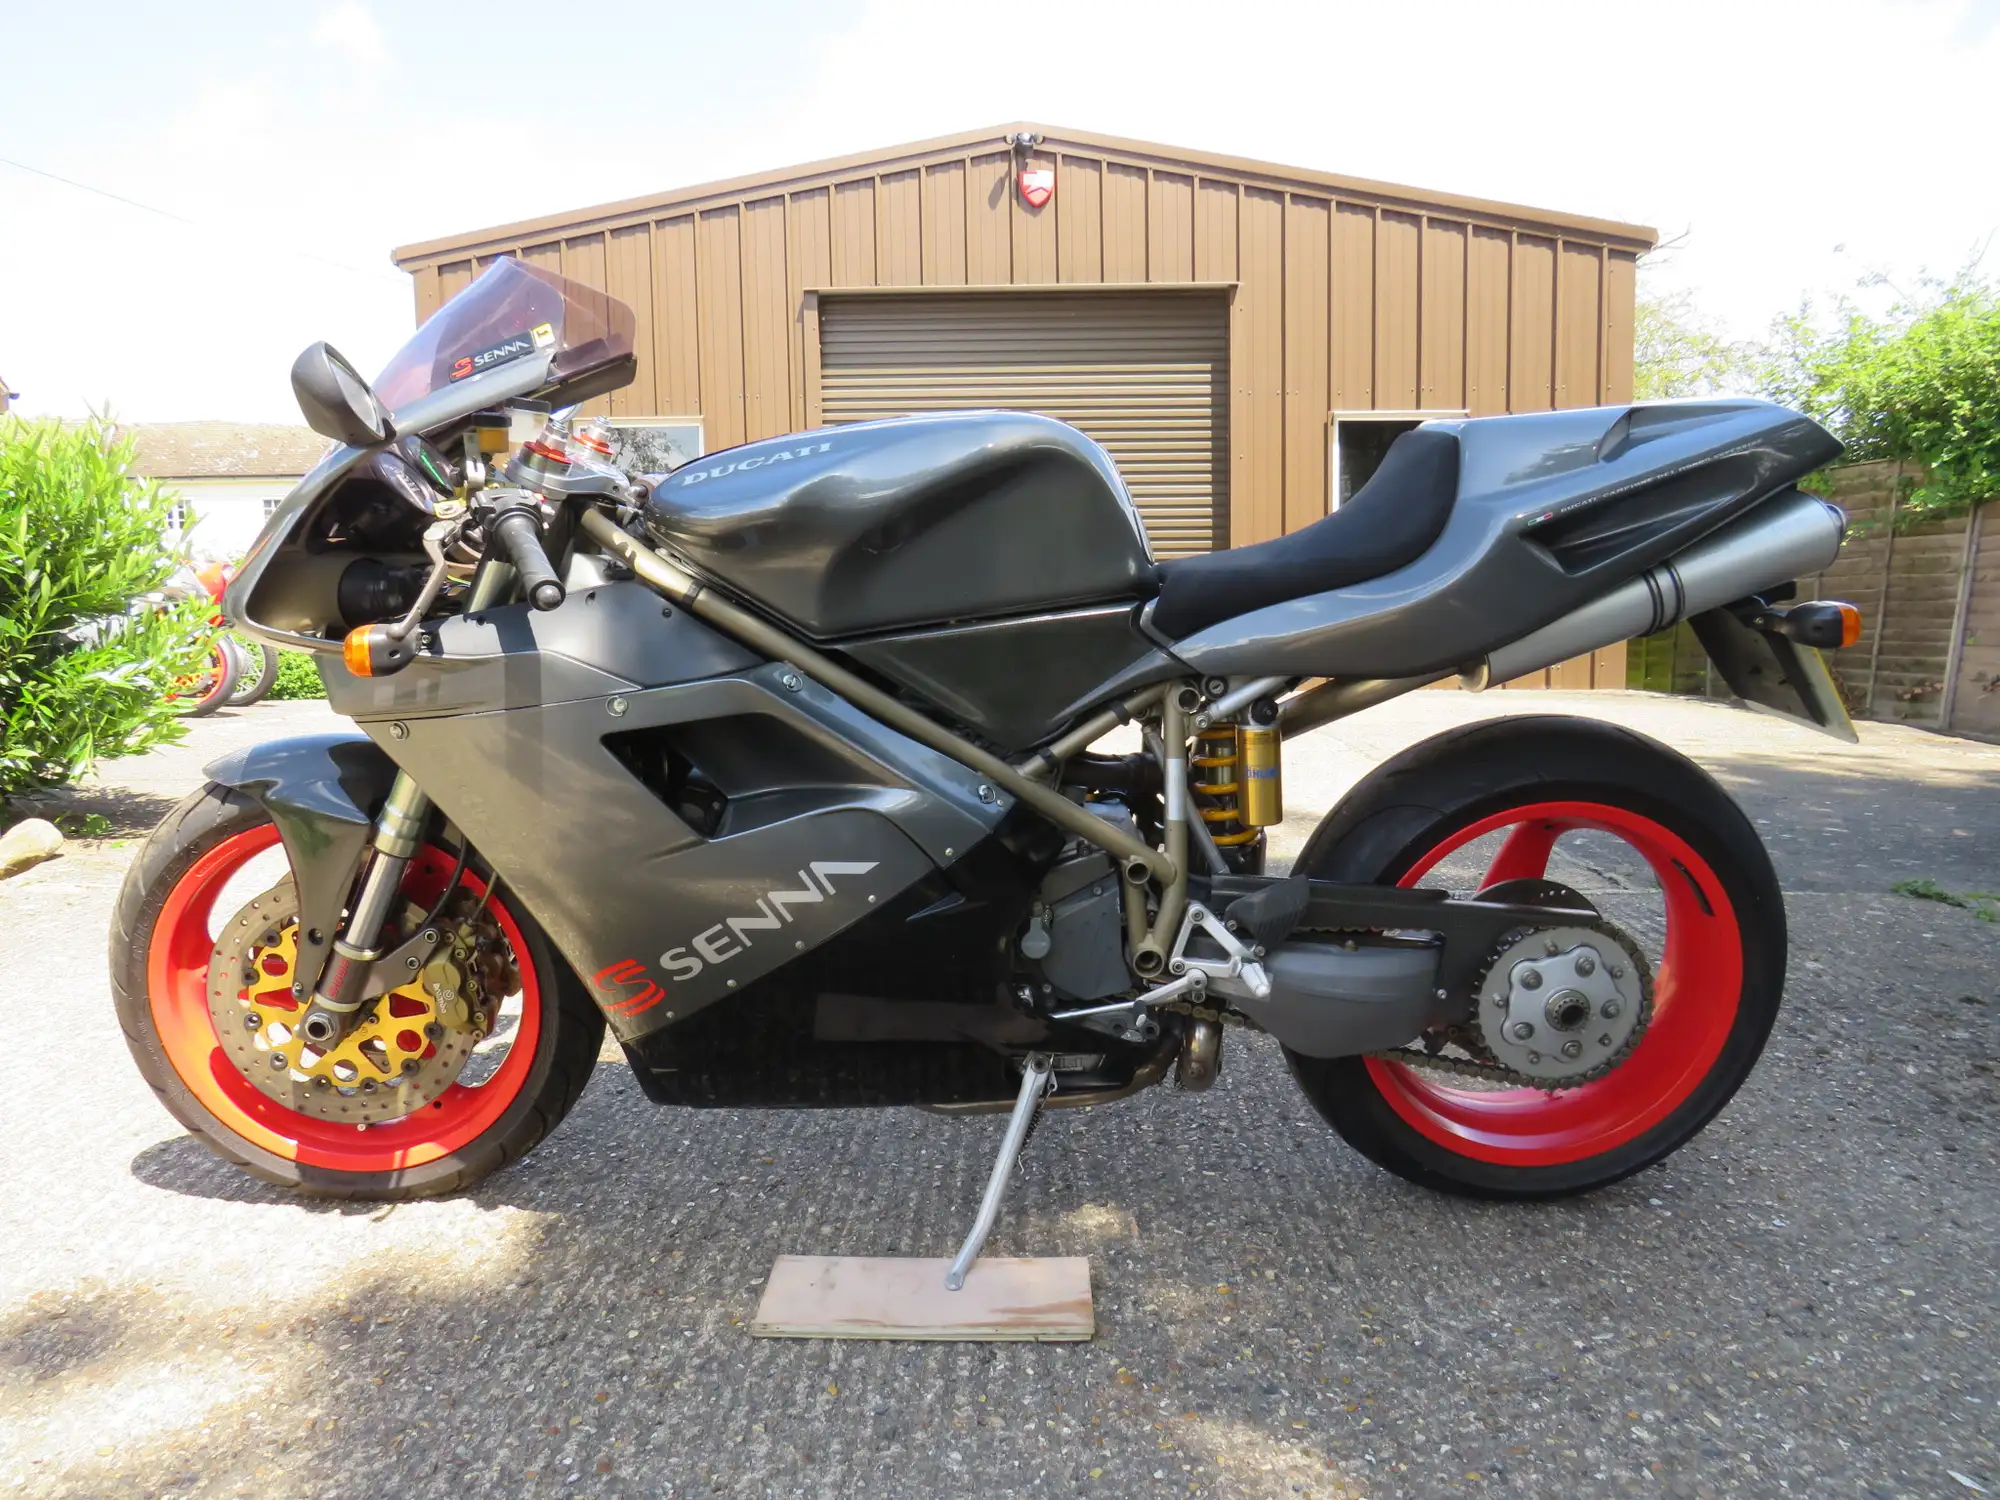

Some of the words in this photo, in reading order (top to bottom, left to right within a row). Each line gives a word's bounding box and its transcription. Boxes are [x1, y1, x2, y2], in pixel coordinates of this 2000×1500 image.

[474, 341, 531, 367] SENNA
[682, 441, 833, 487] DUCATI
[1560, 496, 1598, 513] DUCATI
[659, 861, 881, 982] SENNA
